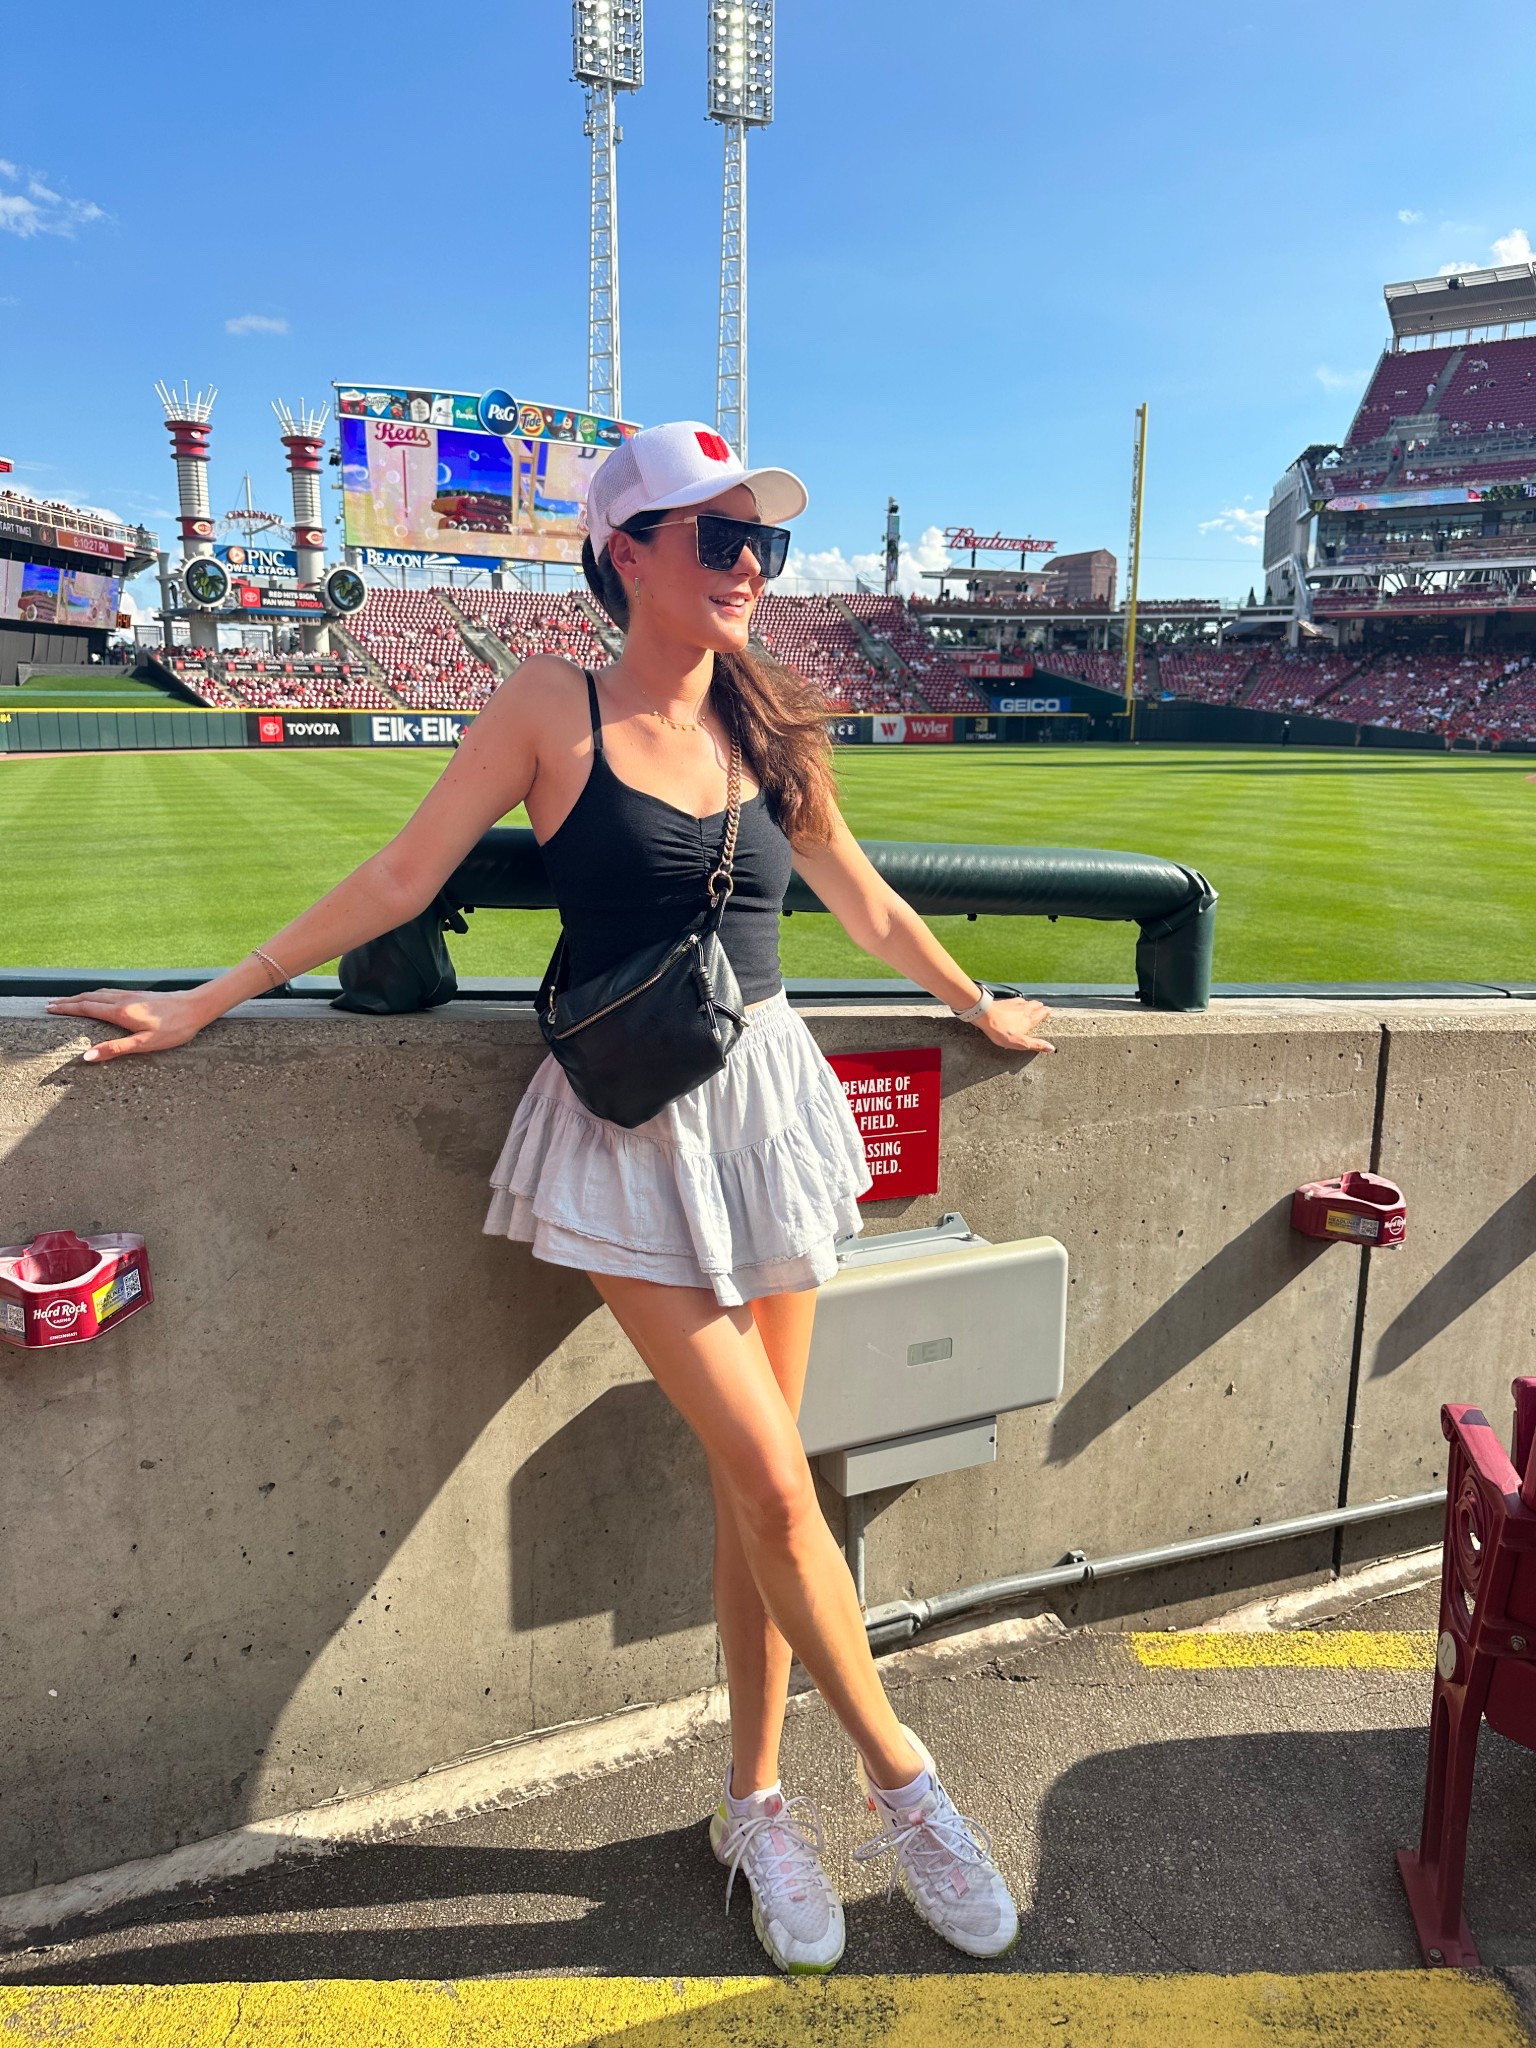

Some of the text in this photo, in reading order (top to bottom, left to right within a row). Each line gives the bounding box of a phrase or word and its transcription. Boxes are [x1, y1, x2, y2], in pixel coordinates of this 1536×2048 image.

[487, 404, 515, 422] P&G
[520, 413, 542, 429] Tide
[375, 423, 430, 445] Reds
[74, 537, 110, 553] 6:10:27 PM
[247, 549, 286, 567] PNC
[366, 548, 422, 568] BEACON
[225, 563, 297, 576] OWER STACKS
[277, 599, 296, 607] WINS
[296, 600, 324, 608] TUNDRA
[283, 591, 298, 599] HITS
[969, 664, 1025, 677] HIT THE BUDS
[1000, 698, 1060, 713] GEICO
[287, 723, 340, 736] TOYOTA
[372, 716, 461, 742] Elk+Elk
[880, 721, 949, 738] W Wyler
[841, 1076, 911, 1096] BEWARE OF
[849, 1093, 920, 1113] EAVING THE
[860, 1114, 899, 1131] FIELD.
[33, 1305, 61, 1320] Hard
[62, 1302, 88, 1317] Rock
[49, 1331, 78, 1340] CINCINNATI
